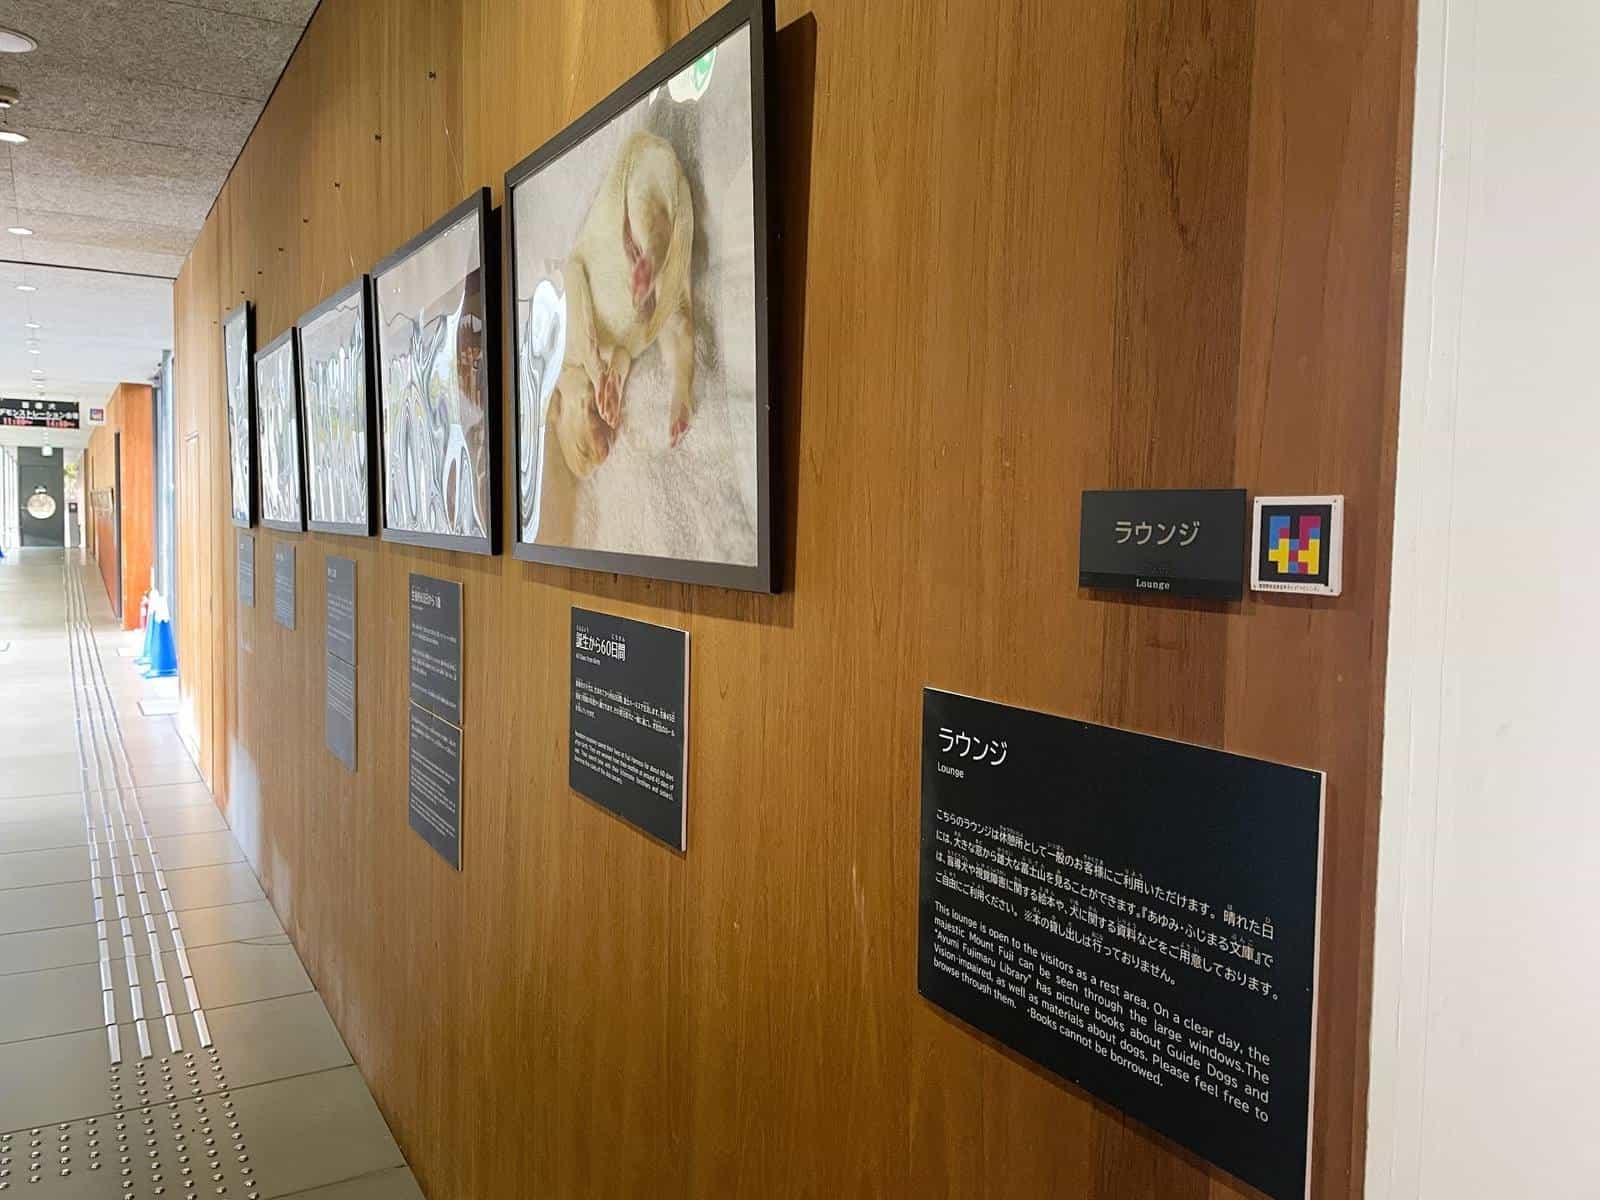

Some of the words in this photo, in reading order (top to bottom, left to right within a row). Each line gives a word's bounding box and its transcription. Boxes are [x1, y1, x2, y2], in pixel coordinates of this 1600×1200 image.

[1115, 520, 1200, 546] ラウンジ
[1135, 579, 1170, 591] Lounge
[936, 761, 964, 779] Lounge
[937, 727, 1008, 766] ラウンジ
[933, 956, 960, 979] browse
[961, 972, 992, 996] through
[993, 988, 1017, 1009] them.
[1059, 1025, 1092, 1049] cannot
[1095, 1040, 1108, 1057] be
[1110, 1048, 1163, 1087] borrowed.
[934, 916, 965, 938] majestic
[969, 931, 994, 953] Mount
[998, 945, 1014, 961] Fuji
[1018, 957, 1034, 972] can
[1039, 964, 1051, 979] be
[1055, 975, 1079, 993] seen
[1084, 987, 1123, 1015] through
[1129, 1008, 1148, 1026] the
[1154, 1018, 1182, 1043] large
[935, 900, 950, 917] This
[951, 908, 978, 929] lounge
[979, 922, 987, 934] is
[988, 928, 1009, 944] open
[1011, 937, 1021, 950] to
[1023, 942, 1039, 958] the
[1040, 951, 1074, 975] visitors
[1076, 968, 1088, 981] as
[1090, 975, 1097, 985] a
[1099, 980, 1120, 997] rest
[1123, 990, 1150, 1010] area.
[1153, 1002, 1169, 1019] On
[1172, 1013, 1180, 1025] a
[1183, 1017, 1214, 1039] clear
[1247, 1046, 1270, 1066] the
[962, 942, 996, 968] Fujimaru
[1035, 978, 1052, 996] has
[1056, 991, 1090, 1015] picture
[1094, 1007, 1125, 1033] books
[1130, 1027, 1161, 1051] about
[1166, 1043, 1201, 1070] Guide
[1207, 1062, 1238, 1089] Dogs
[1244, 1084, 1269, 1104] and
[995, 976, 1006, 988] as
[1008, 983, 1026, 998] well
[1028, 993, 1039, 1005] as
[1041, 999, 1084, 1029] materials
[1087, 1023, 1116, 1045] about
[1119, 1038, 1148, 1062] dogs.
[1152, 1053, 1190, 1082] Please
[1194, 1075, 1218, 1098] feel
[1223, 1089, 1250, 1113] free
[1255, 1106, 1269, 1122] to
